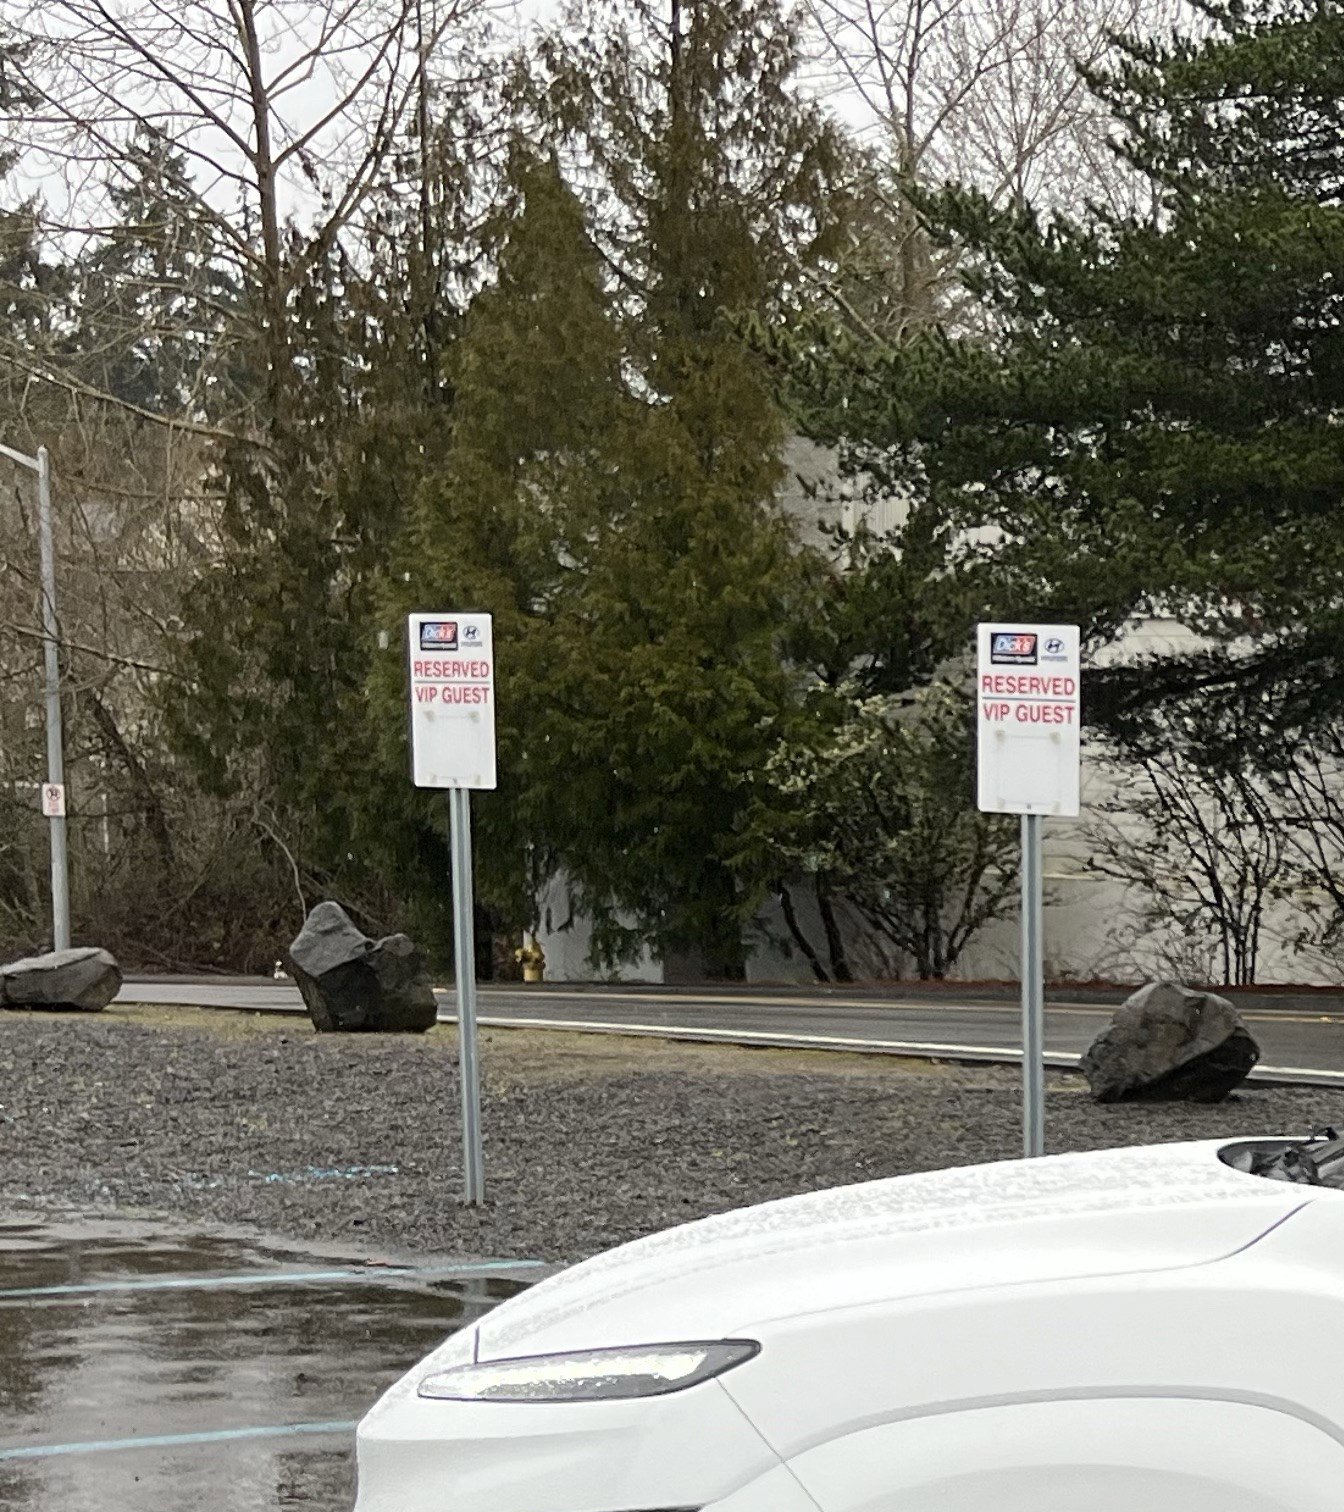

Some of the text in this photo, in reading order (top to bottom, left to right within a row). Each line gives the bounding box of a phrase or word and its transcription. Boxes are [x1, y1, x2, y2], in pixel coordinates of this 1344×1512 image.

[413, 660, 490, 678] RESERVED
[416, 686, 490, 704] VIP GUEST
[982, 674, 1075, 696] RESERVED
[983, 702, 1075, 724] VIP GUEST
